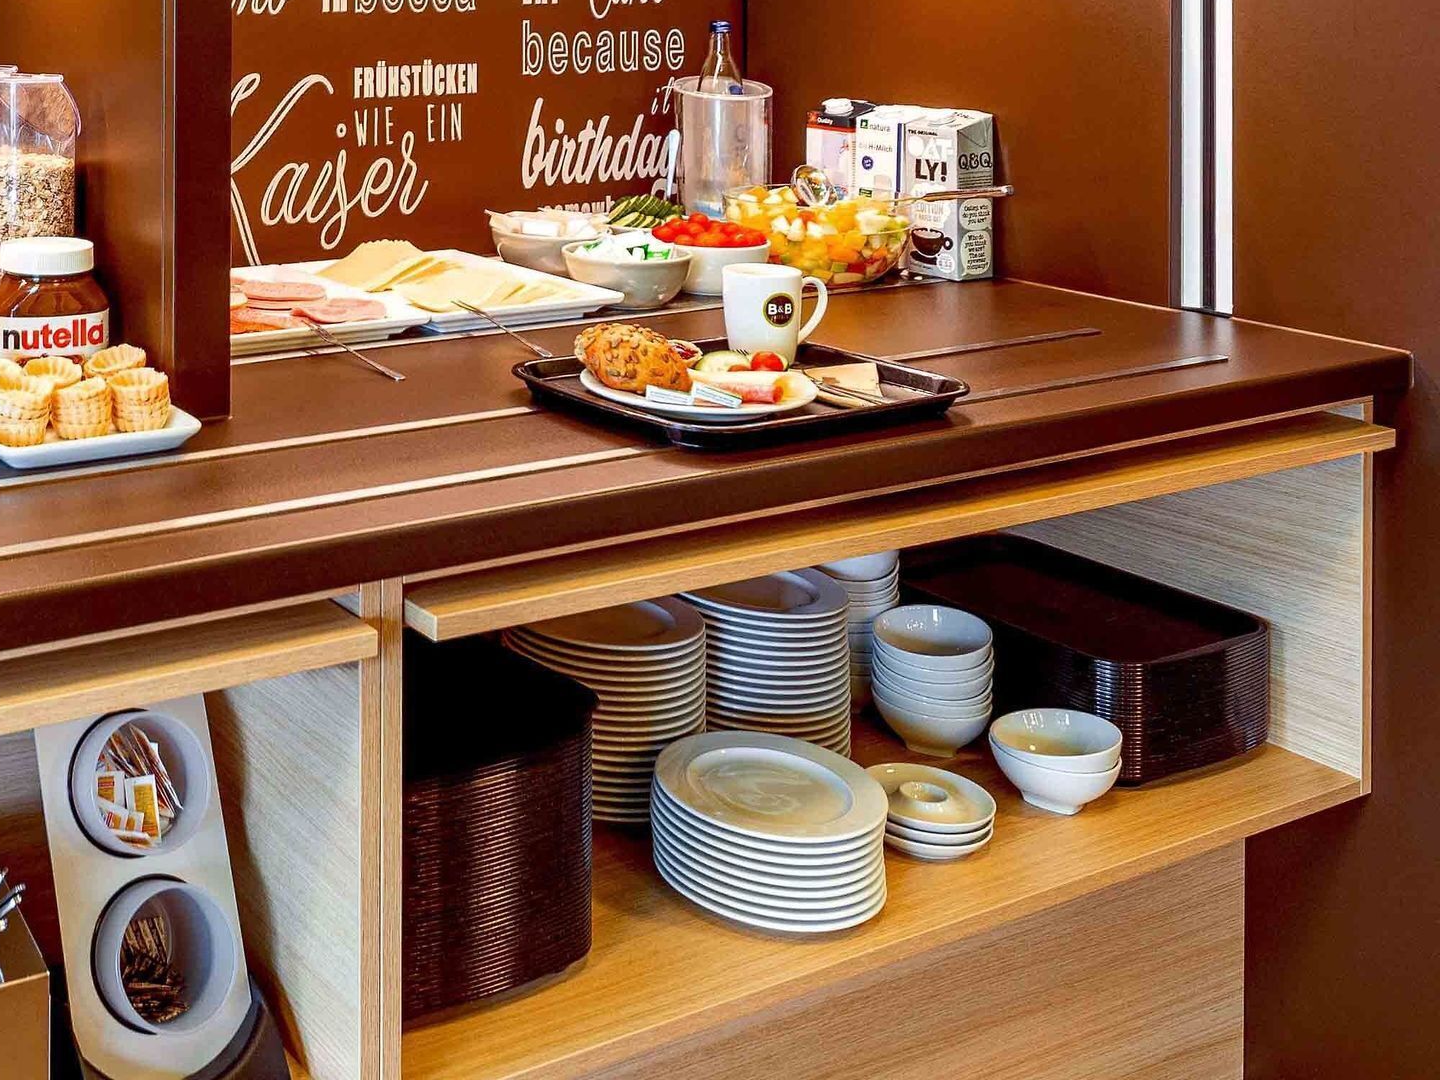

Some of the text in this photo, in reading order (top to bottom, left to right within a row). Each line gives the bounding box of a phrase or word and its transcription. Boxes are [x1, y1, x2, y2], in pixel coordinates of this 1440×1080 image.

[522, 20, 685, 76] because
[354, 58, 479, 100] FRÜHSTÜCKEN
[355, 103, 463, 148] WIE EIN
[915, 158, 948, 182] LY!
[958, 151, 993, 171] Q&Q
[767, 303, 793, 316] B&B
[2, 318, 104, 350] nutella
